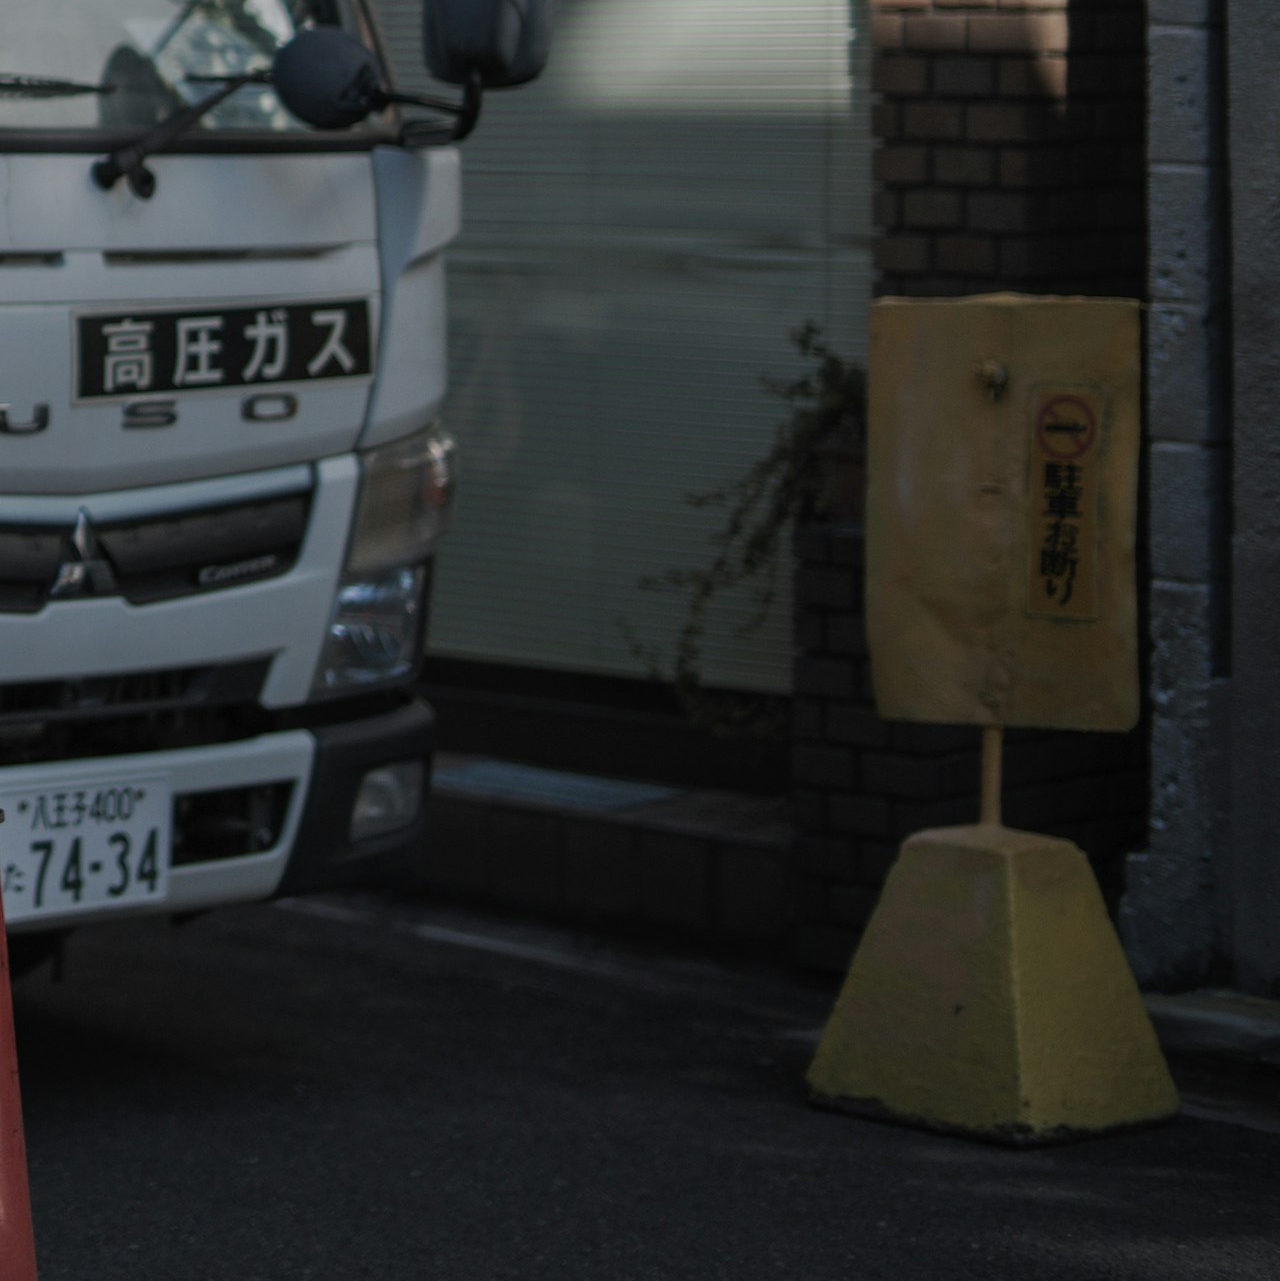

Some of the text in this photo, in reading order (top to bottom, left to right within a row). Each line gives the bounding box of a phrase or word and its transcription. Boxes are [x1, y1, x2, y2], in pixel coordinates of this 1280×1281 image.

[100, 307, 356, 395] 高圧ガス
[30, 827, 160, 908] 74-34
